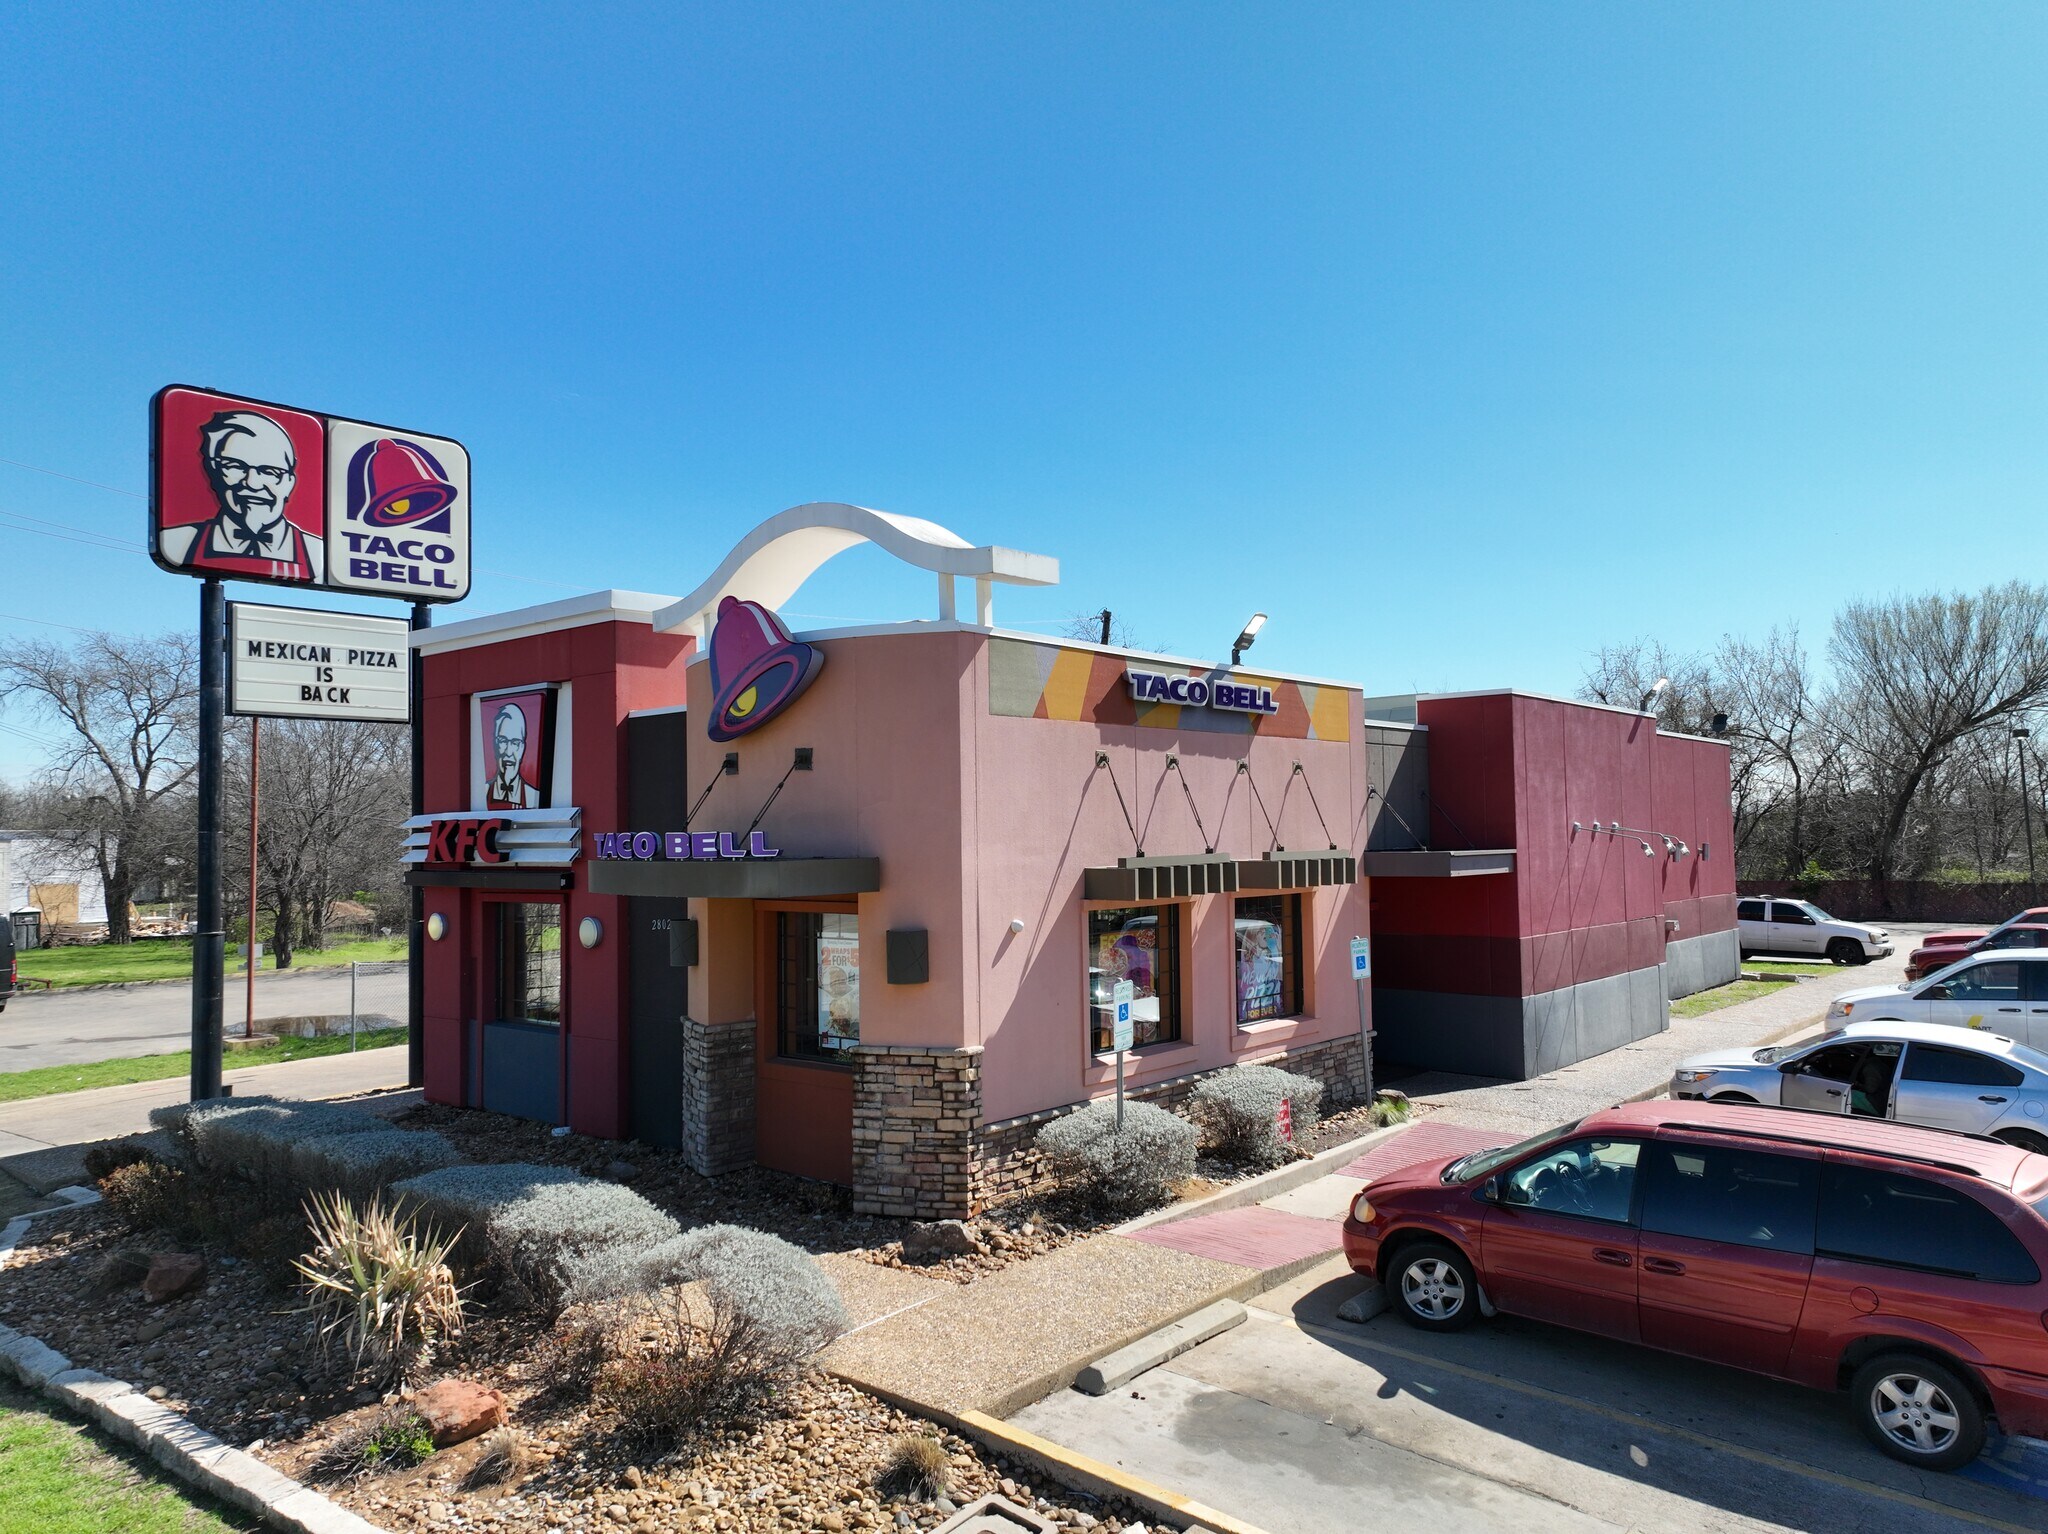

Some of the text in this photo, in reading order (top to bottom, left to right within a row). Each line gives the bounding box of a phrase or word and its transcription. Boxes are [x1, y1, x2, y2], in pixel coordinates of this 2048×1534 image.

[340, 531, 455, 564] TACO
[350, 558, 457, 589] BELL
[248, 640, 398, 668] MEXICAN PIZZA
[316, 666, 333, 683] IS
[301, 685, 350, 704] BACK
[1130, 673, 1278, 712] TACO BELL
[425, 818, 504, 864] KFC
[593, 831, 780, 860] TACO BELL
[651, 919, 671, 931] 2802
[832, 955, 847, 966] FOR
[1242, 981, 1282, 1011] PIZZA
[1248, 1004, 1278, 1018] FOREVER
